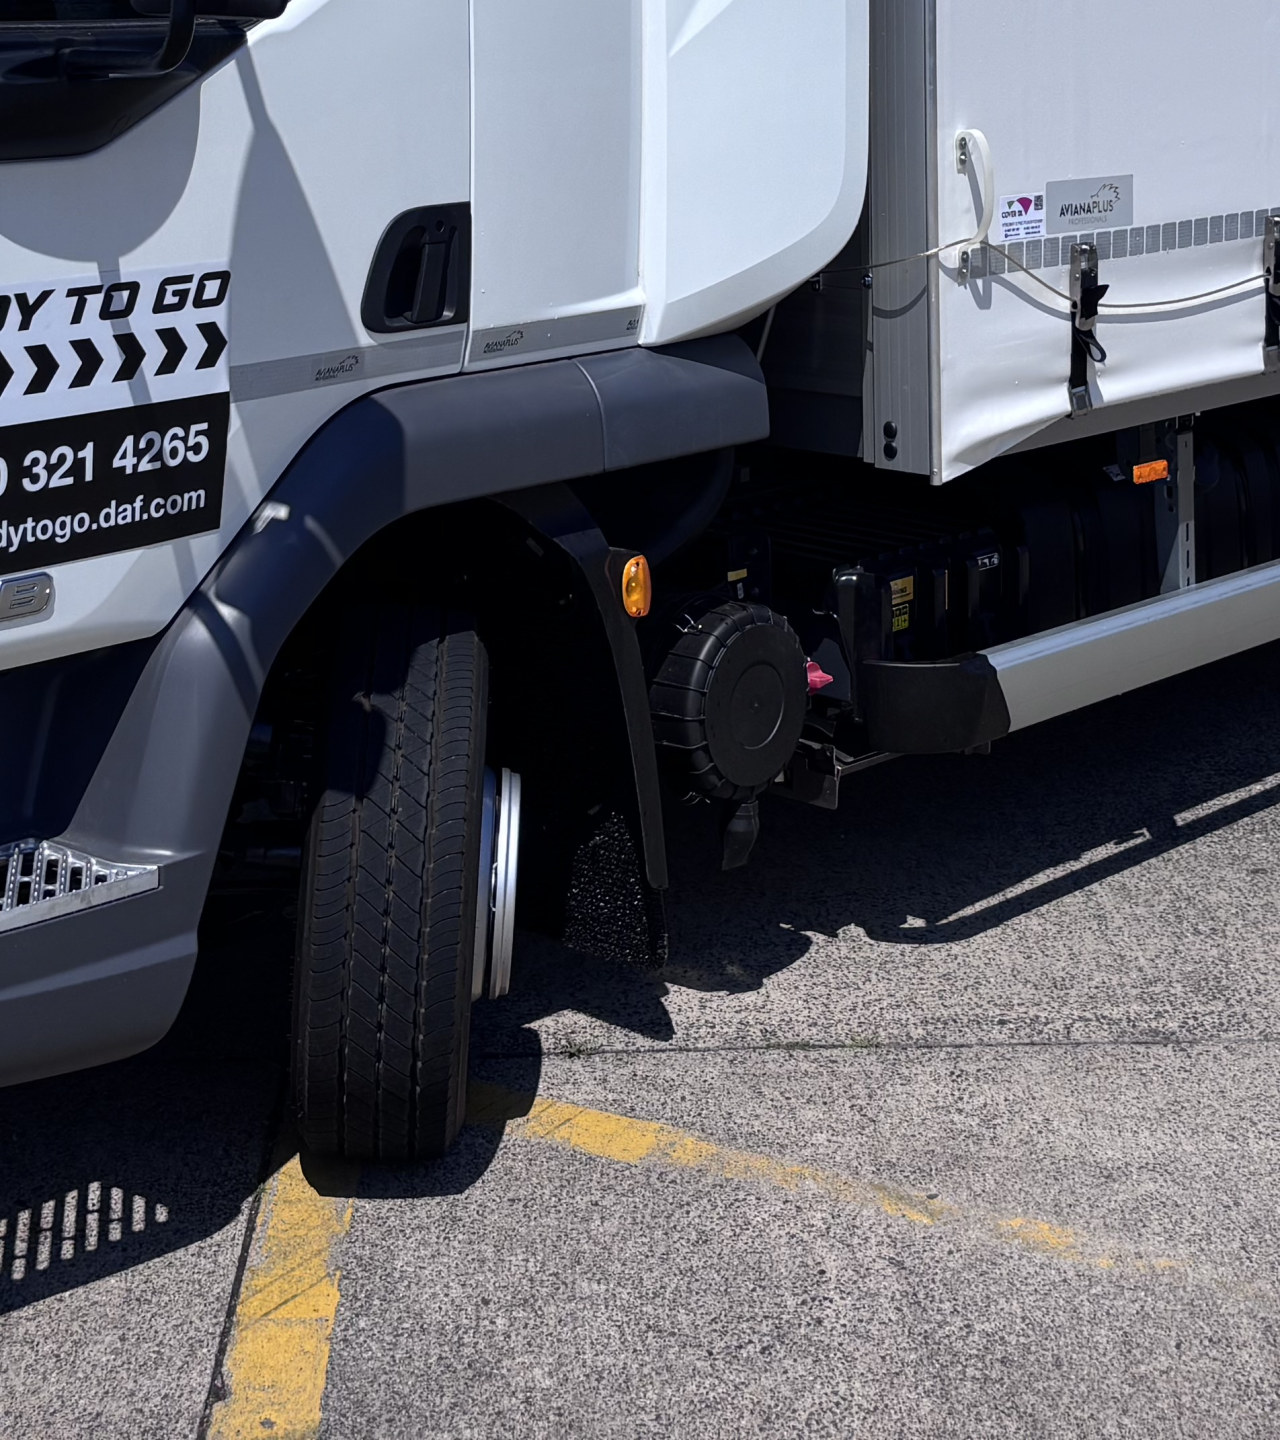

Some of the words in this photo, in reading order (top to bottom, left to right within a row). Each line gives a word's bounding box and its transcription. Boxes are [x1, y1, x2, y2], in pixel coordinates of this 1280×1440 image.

[1059, 200, 1114, 217] AVIANAPLUS
[65, 280, 141, 325] TO
[151, 270, 231, 314] GO
[21, 441, 94, 492] 321
[112, 422, 210, 475] 4265
